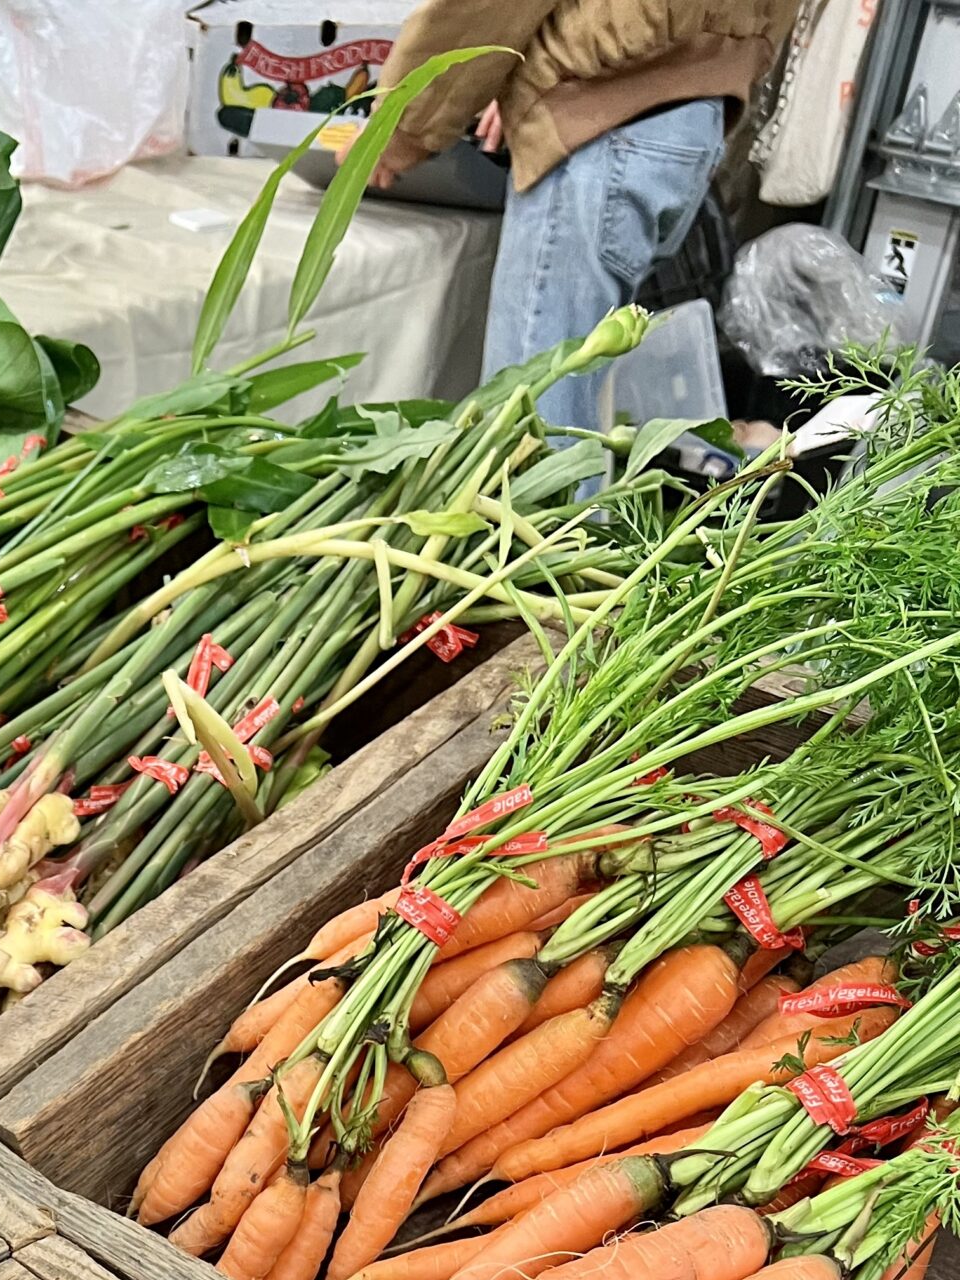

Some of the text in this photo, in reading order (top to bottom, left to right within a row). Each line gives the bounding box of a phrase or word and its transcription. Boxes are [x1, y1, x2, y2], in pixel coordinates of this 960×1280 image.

[244, 43, 390, 81] FRESH PRODUC
[493, 790, 532, 813] table
[726, 888, 765, 933] Vegetab
[782, 994, 822, 1013] Fresh
[793, 1080, 823, 1108] Fresh
[818, 1072, 847, 1102] Fresh
